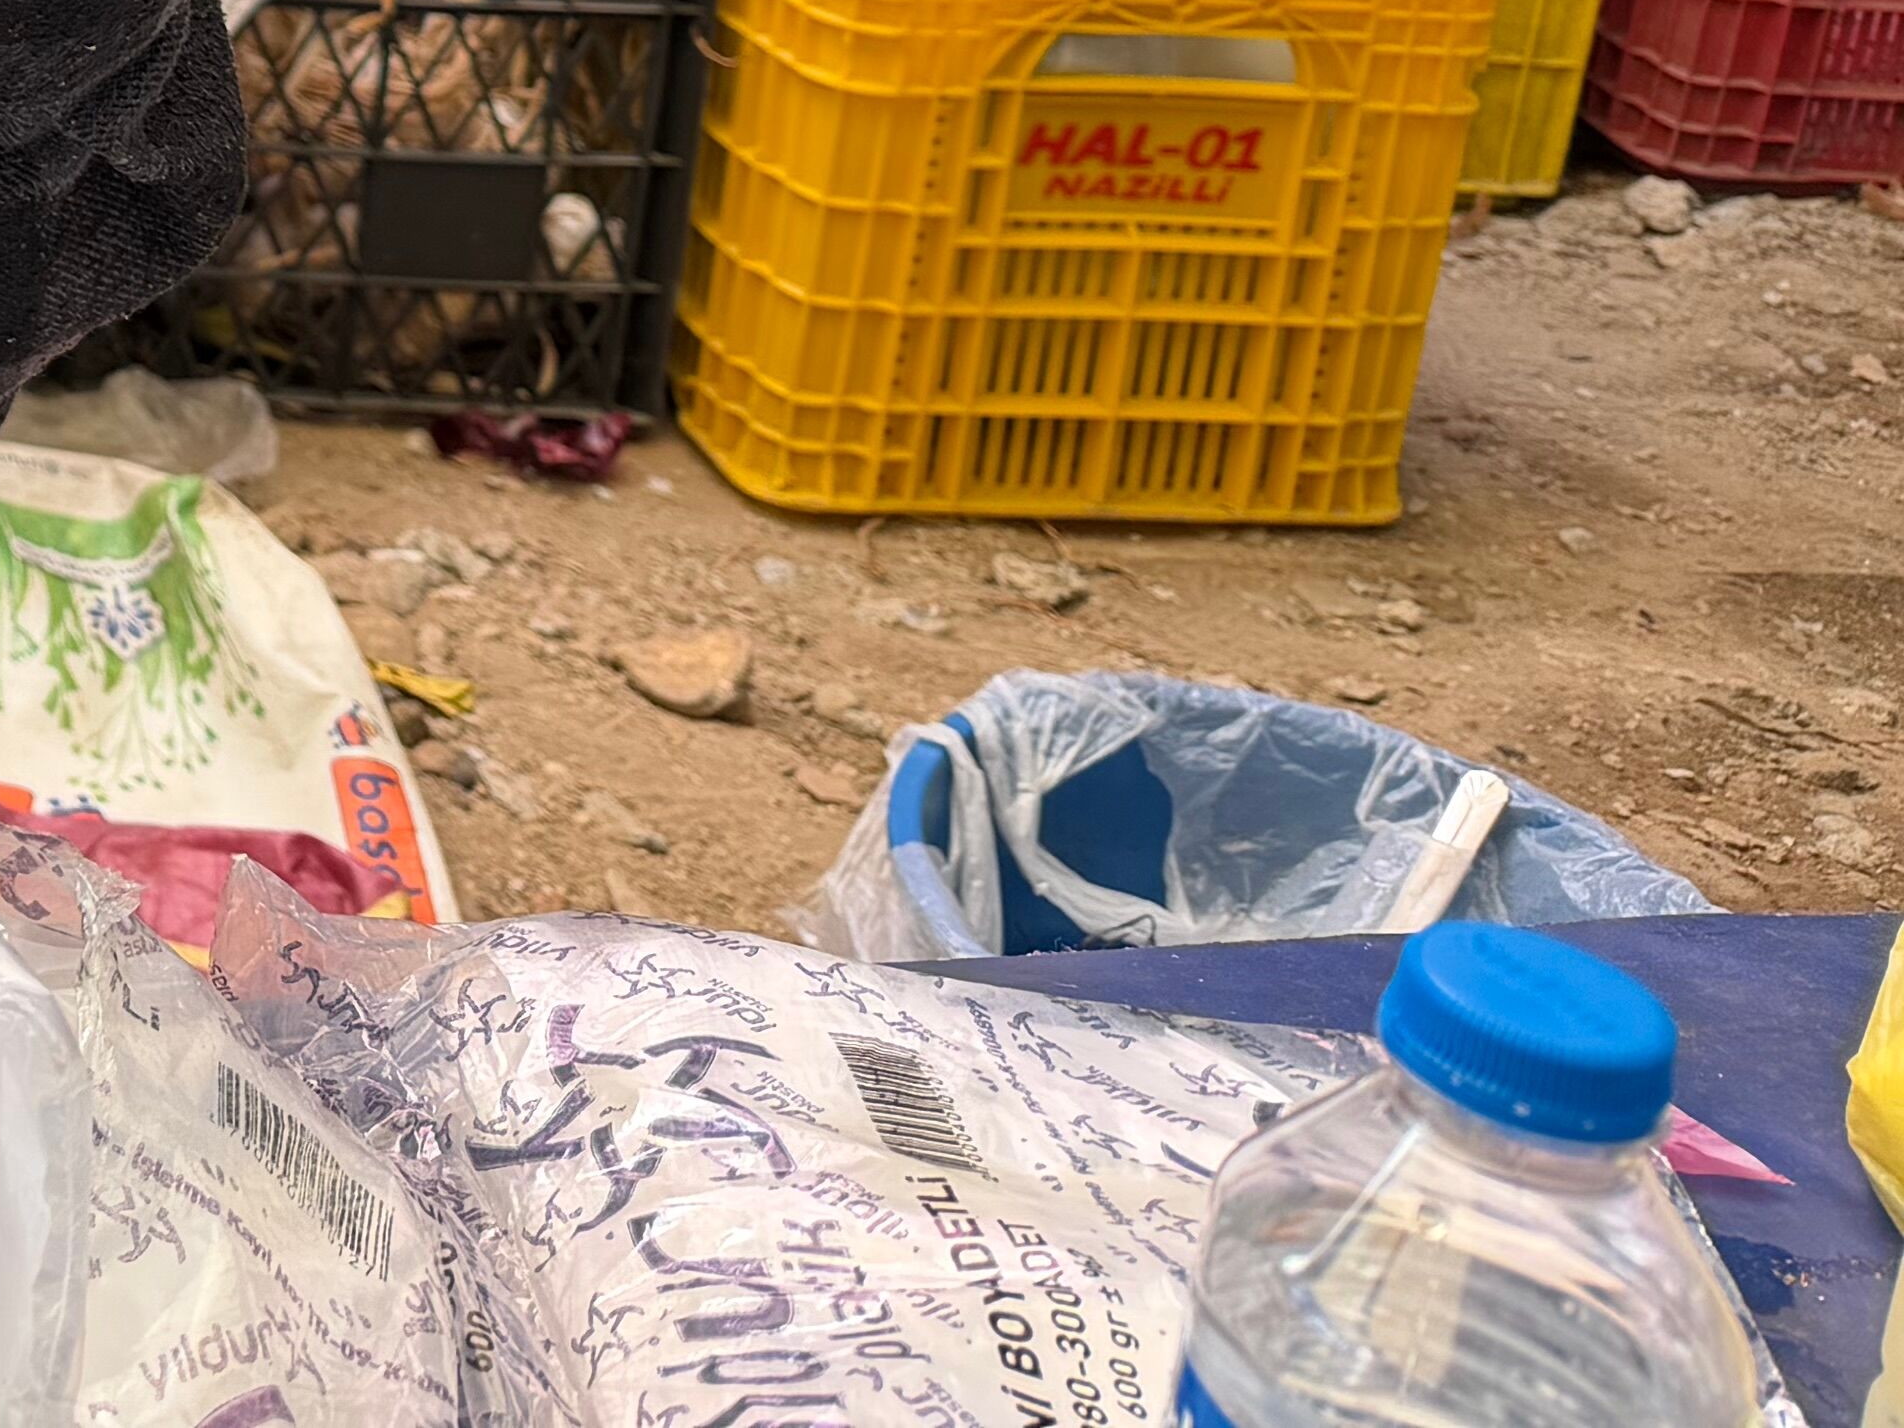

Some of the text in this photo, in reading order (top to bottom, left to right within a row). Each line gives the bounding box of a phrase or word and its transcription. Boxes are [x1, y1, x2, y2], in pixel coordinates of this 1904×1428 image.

[1019, 121, 1264, 173] HAL-01
[1105, 1309, 1141, 1351] gr
[1108, 1357, 1148, 1420] 600
